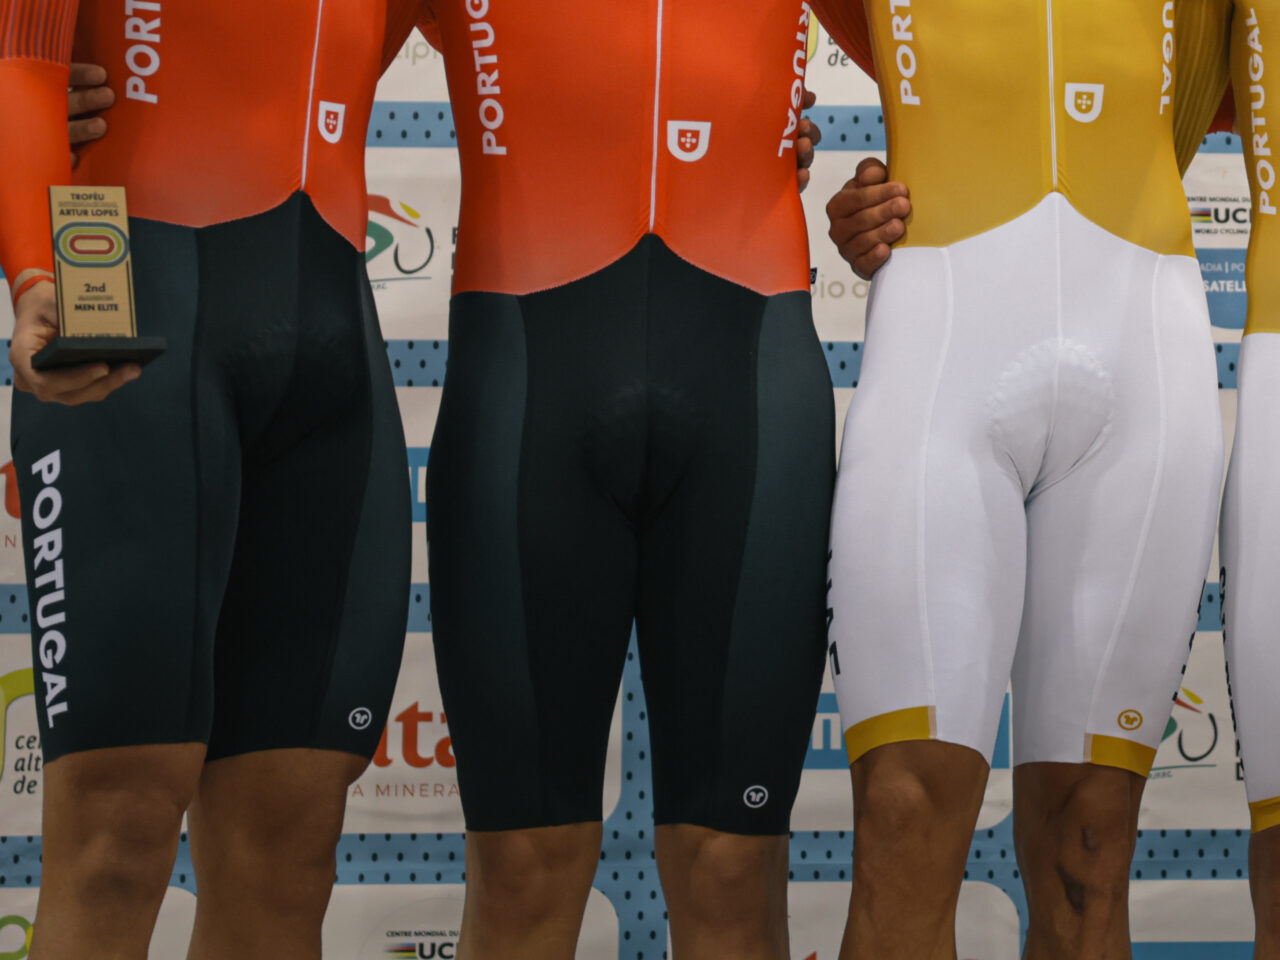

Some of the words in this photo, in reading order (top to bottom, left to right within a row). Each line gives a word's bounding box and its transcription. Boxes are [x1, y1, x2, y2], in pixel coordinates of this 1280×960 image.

[1246, 7, 1278, 216] PORTUGAL
[59, 209, 89, 217] ARTUR
[91, 209, 119, 217] LOPES
[1201, 262, 1222, 272] ADIA
[84, 283, 106, 293] 2nd
[31, 448, 69, 729] PORTUGAL
[14, 753, 41, 772] alt
[13, 774, 38, 794] de
[376, 783, 460, 798] MINERA
[417, 942, 458, 960] UC
